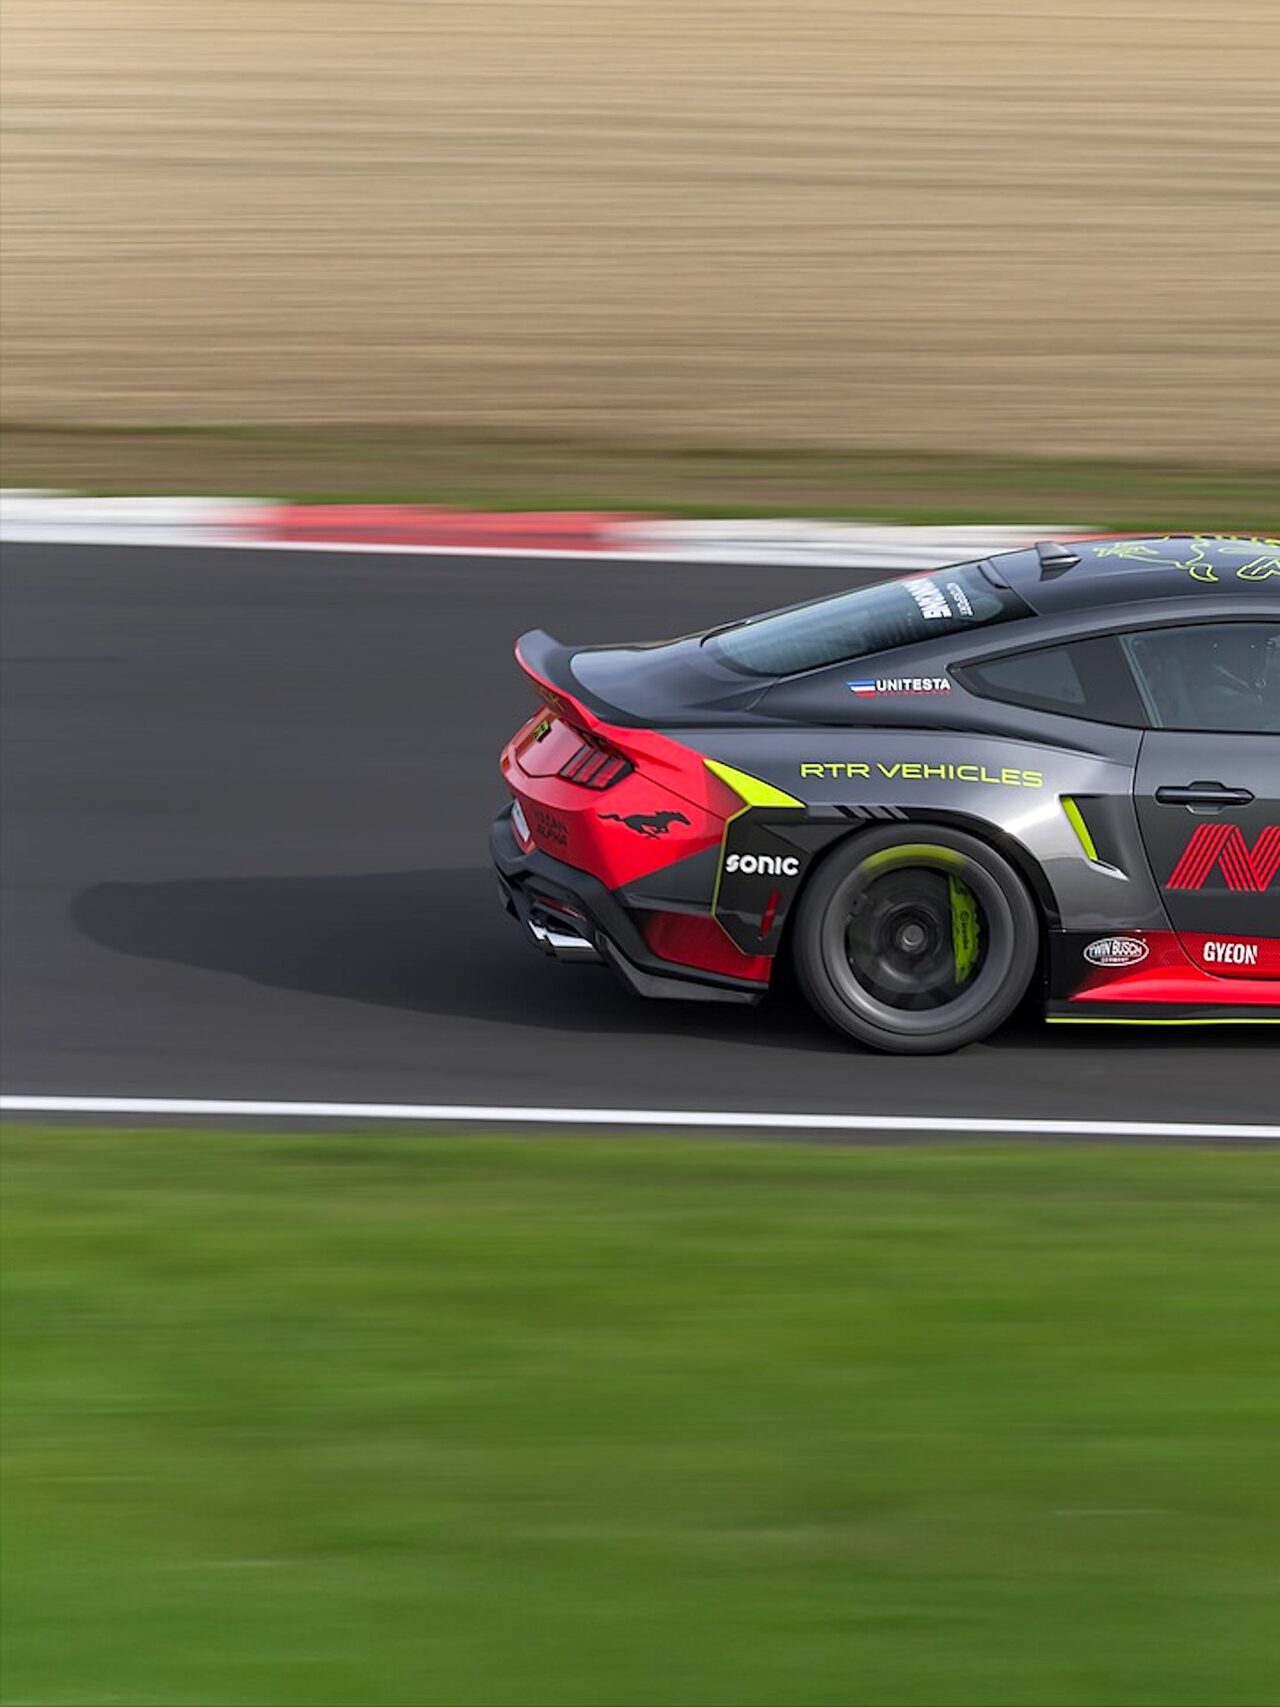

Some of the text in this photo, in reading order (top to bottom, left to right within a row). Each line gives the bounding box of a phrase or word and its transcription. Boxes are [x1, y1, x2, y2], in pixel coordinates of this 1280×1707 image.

[876, 678, 951, 691] UNITESTA
[800, 763, 1044, 788] RTR VEHICLES
[1203, 941, 1258, 965] GYEON
